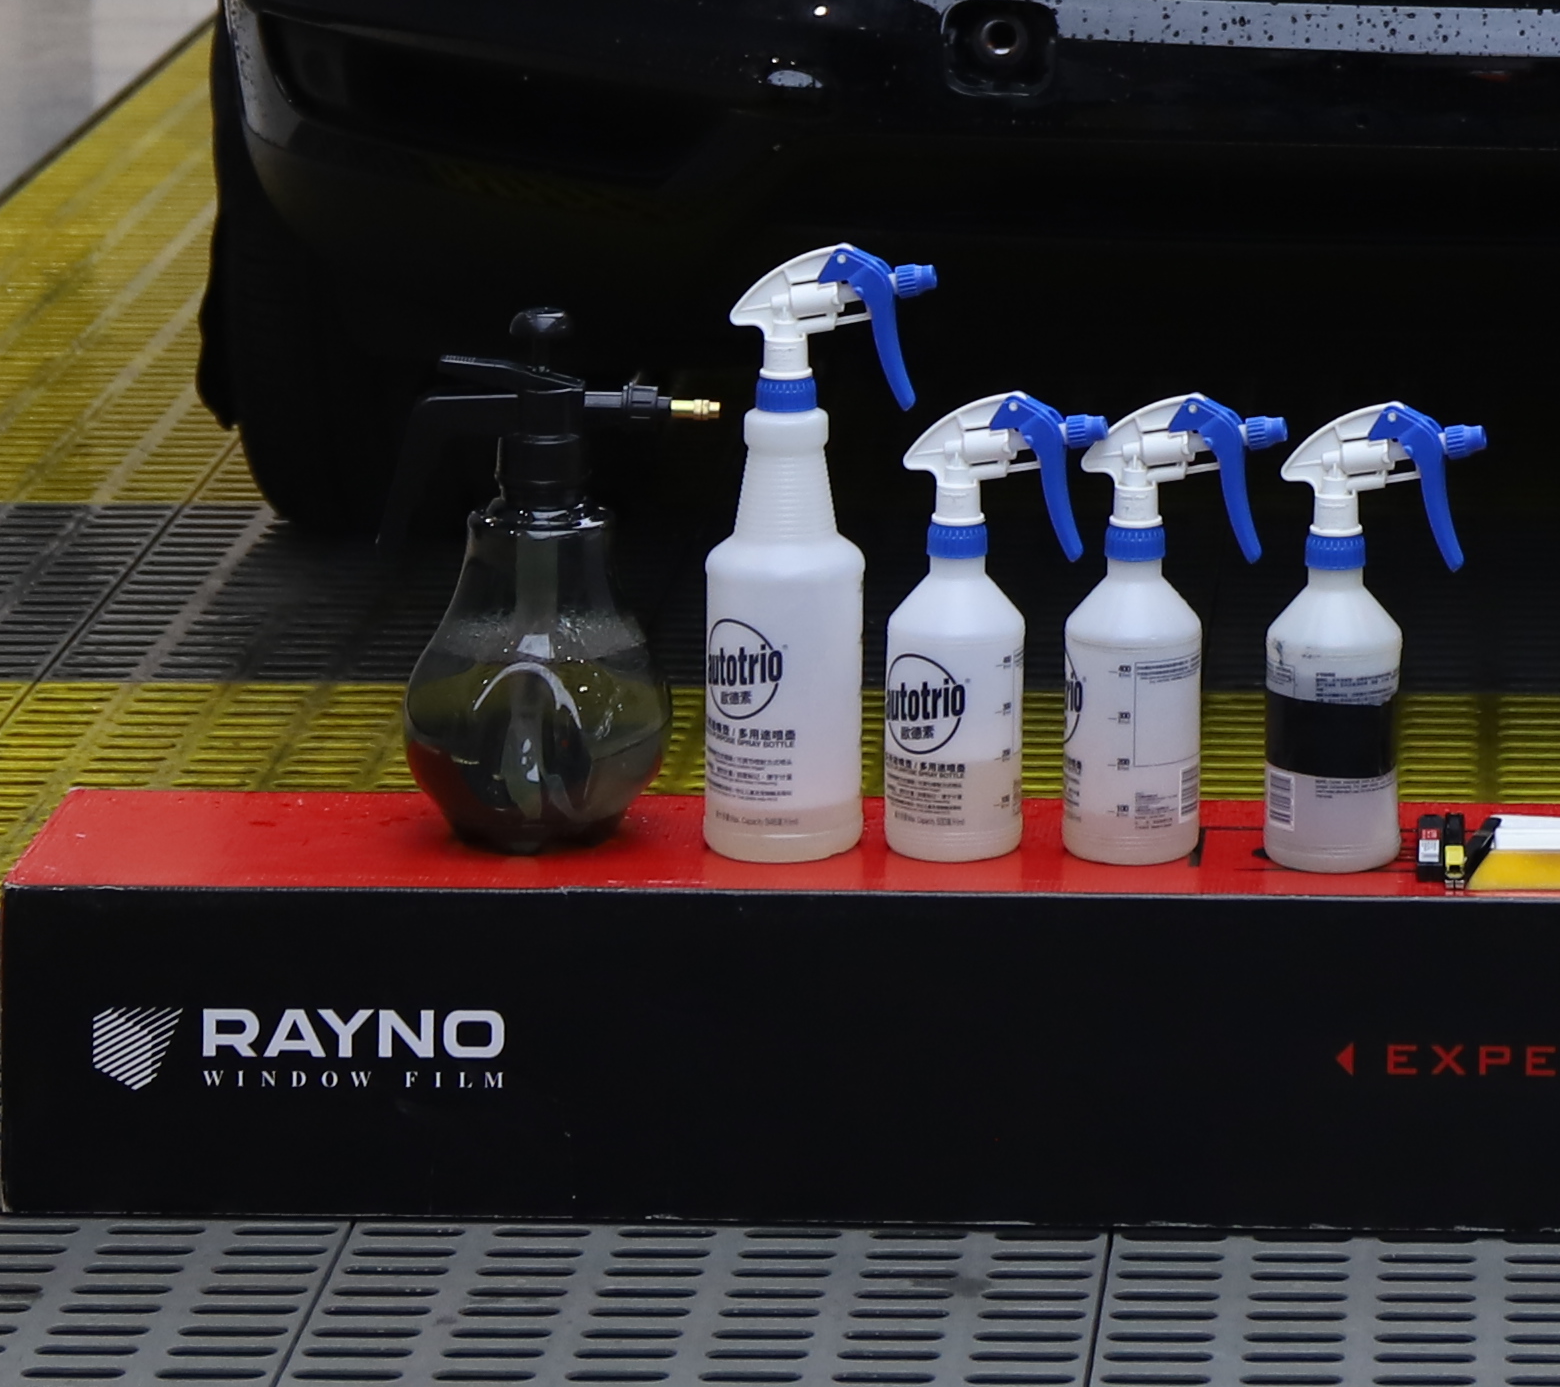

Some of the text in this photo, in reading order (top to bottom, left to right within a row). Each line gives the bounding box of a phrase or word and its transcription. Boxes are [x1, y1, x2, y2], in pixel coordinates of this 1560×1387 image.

[708, 643, 783, 687] autotrio
[886, 677, 966, 721] autotrio
[202, 1008, 505, 1058] RAYNO
[203, 1069, 505, 1089] WINDOW FILM
